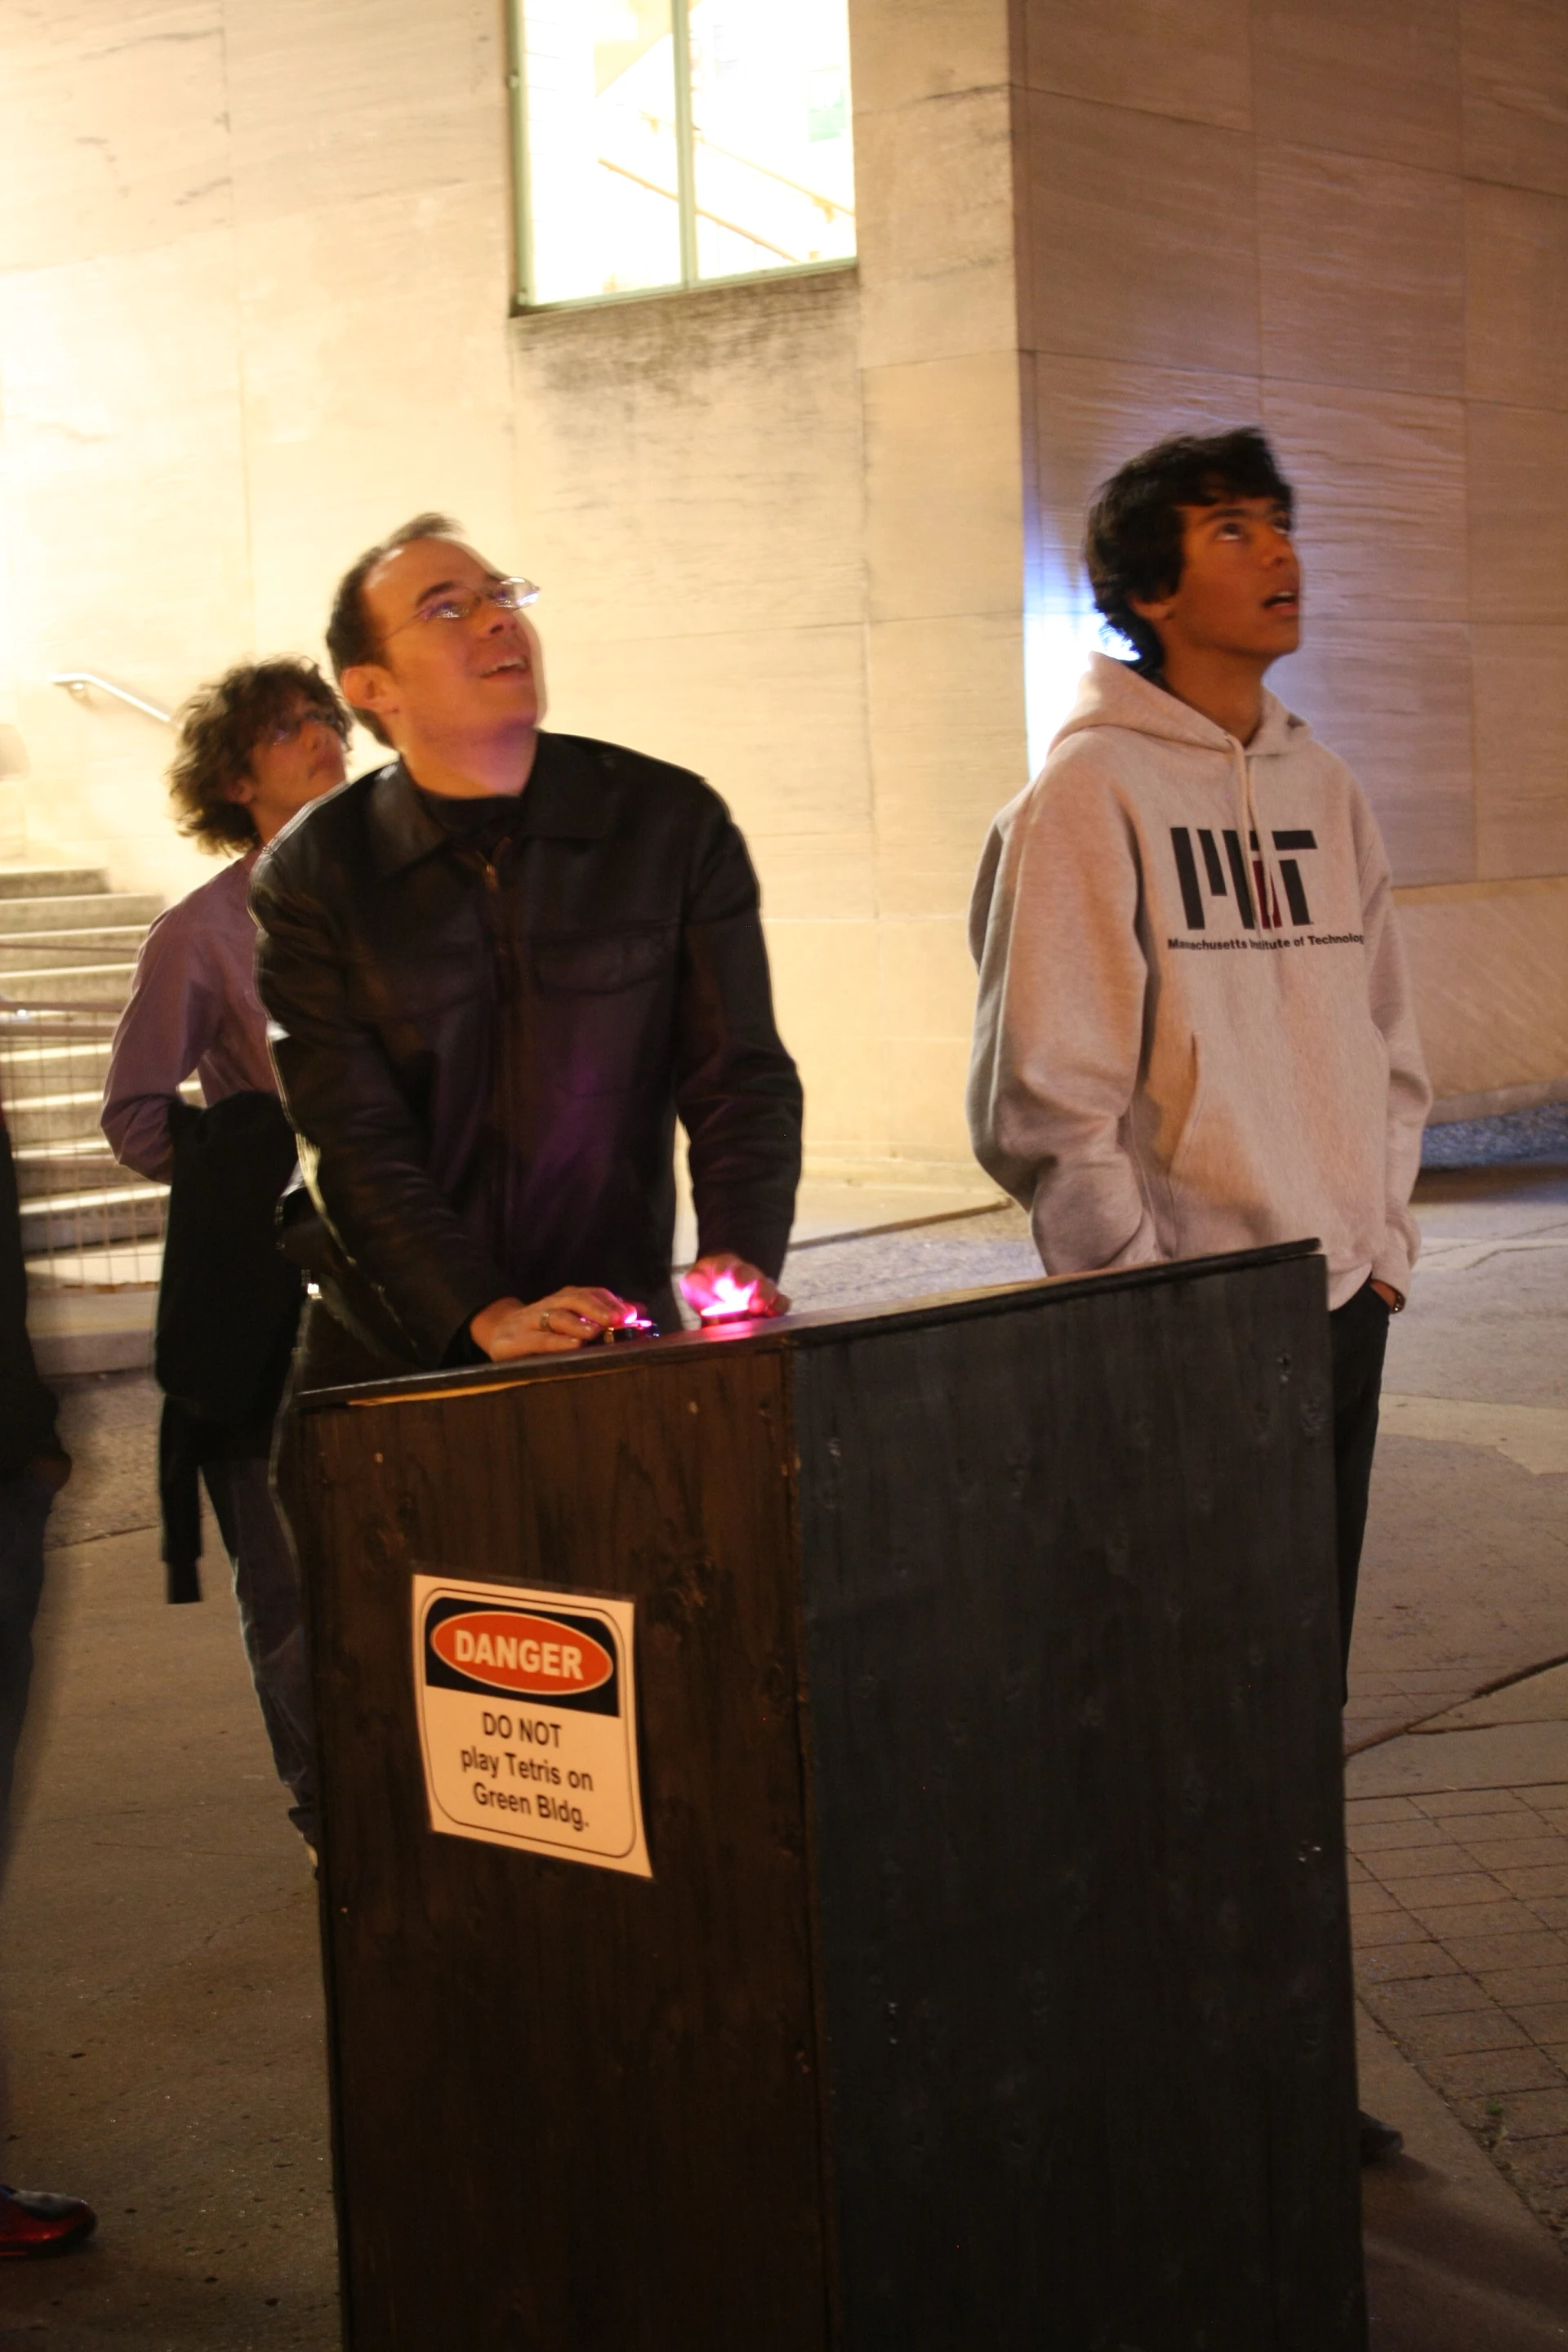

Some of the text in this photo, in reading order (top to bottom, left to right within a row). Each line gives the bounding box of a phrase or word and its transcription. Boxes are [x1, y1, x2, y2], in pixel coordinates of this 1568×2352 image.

[1169, 826, 1318, 930] MIT
[1294, 937, 1305, 947] of
[1307, 933, 1365, 946] Technolog
[454, 1629, 584, 1681] DANGER
[482, 1711, 563, 1748] DO NOT
[460, 1747, 594, 1792] play Tetris on
[473, 1781, 590, 1832] Green Bldg.
